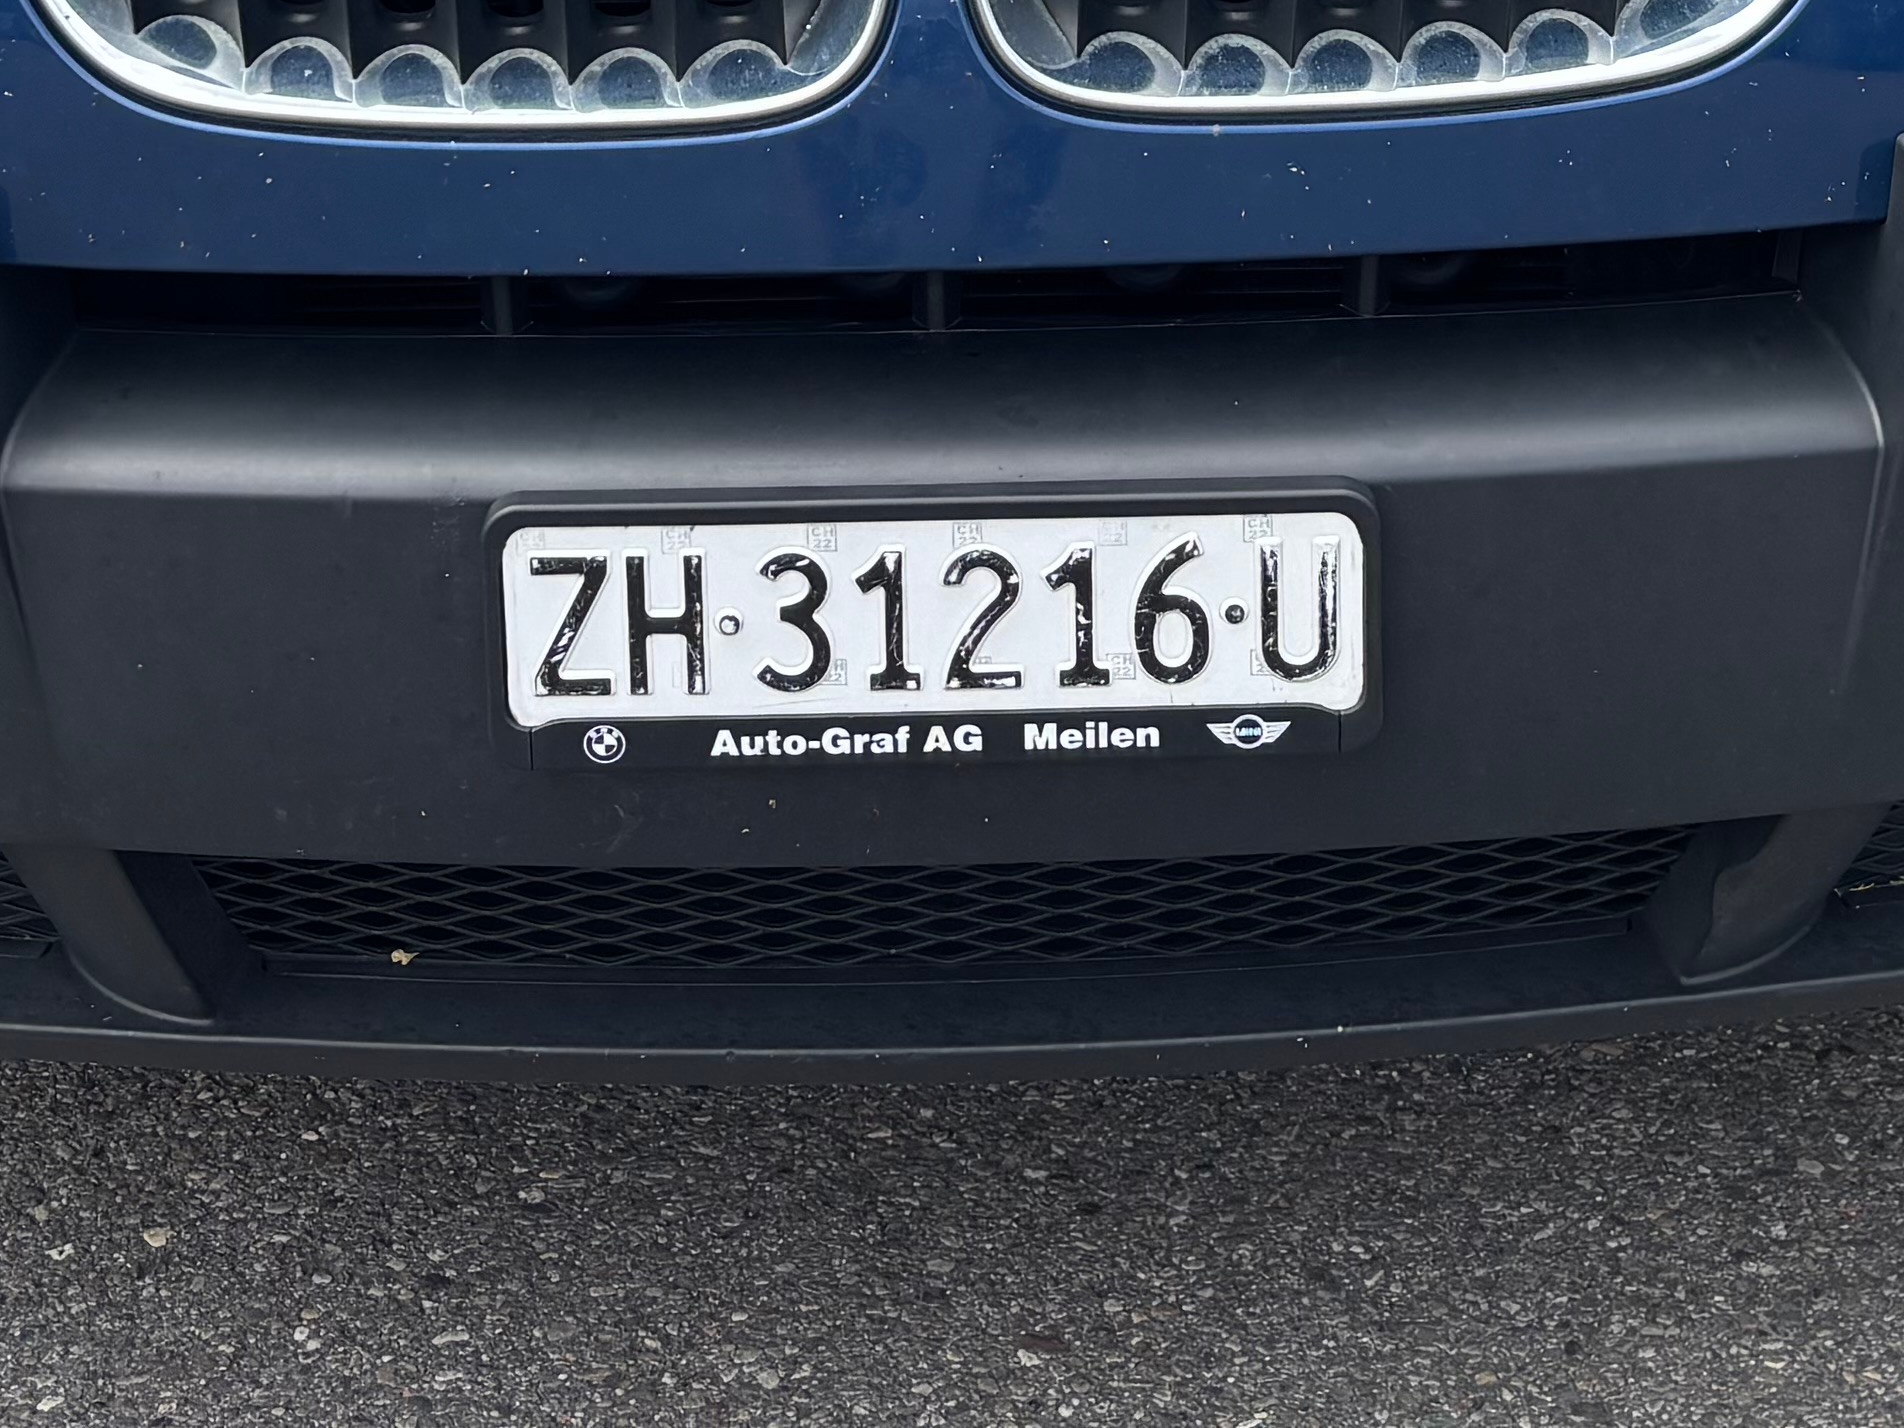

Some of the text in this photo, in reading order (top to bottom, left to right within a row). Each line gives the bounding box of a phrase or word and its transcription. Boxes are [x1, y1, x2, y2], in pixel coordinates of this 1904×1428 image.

[711, 722, 1159, 756] Auto-Graf AG Meilen
